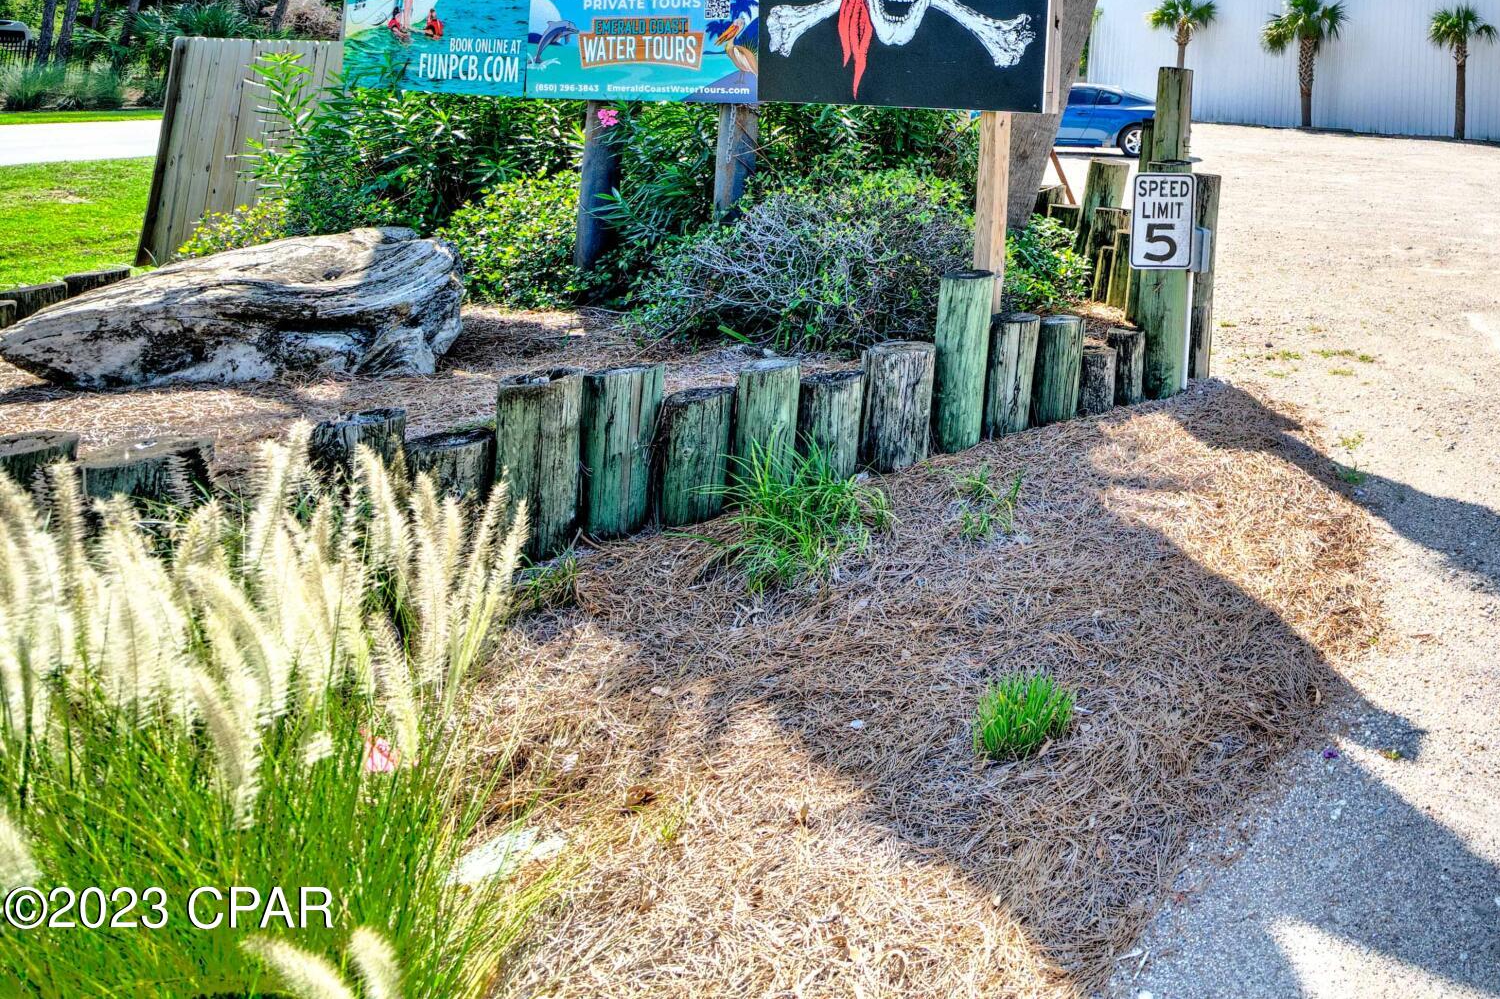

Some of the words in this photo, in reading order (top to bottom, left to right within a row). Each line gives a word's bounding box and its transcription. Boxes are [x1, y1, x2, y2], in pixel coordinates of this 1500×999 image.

[595, 19, 646, 35] EMERALD
[649, 18, 688, 34] COAST
[449, 38, 473, 53] BOOK
[475, 38, 508, 54] ONLINE
[509, 40, 522, 54] AT
[583, 36, 636, 63] WATER
[644, 36, 697, 64] TOURS
[418, 53, 519, 83] FUNPCB.COM
[535, 83, 557, 93] (850)
[607, 84, 750, 95] EmeraldCoastWaterTours.com
[1138, 180, 1189, 198] SPEED
[1142, 201, 1184, 219] LIMIT
[1143, 223, 1177, 262] 5
